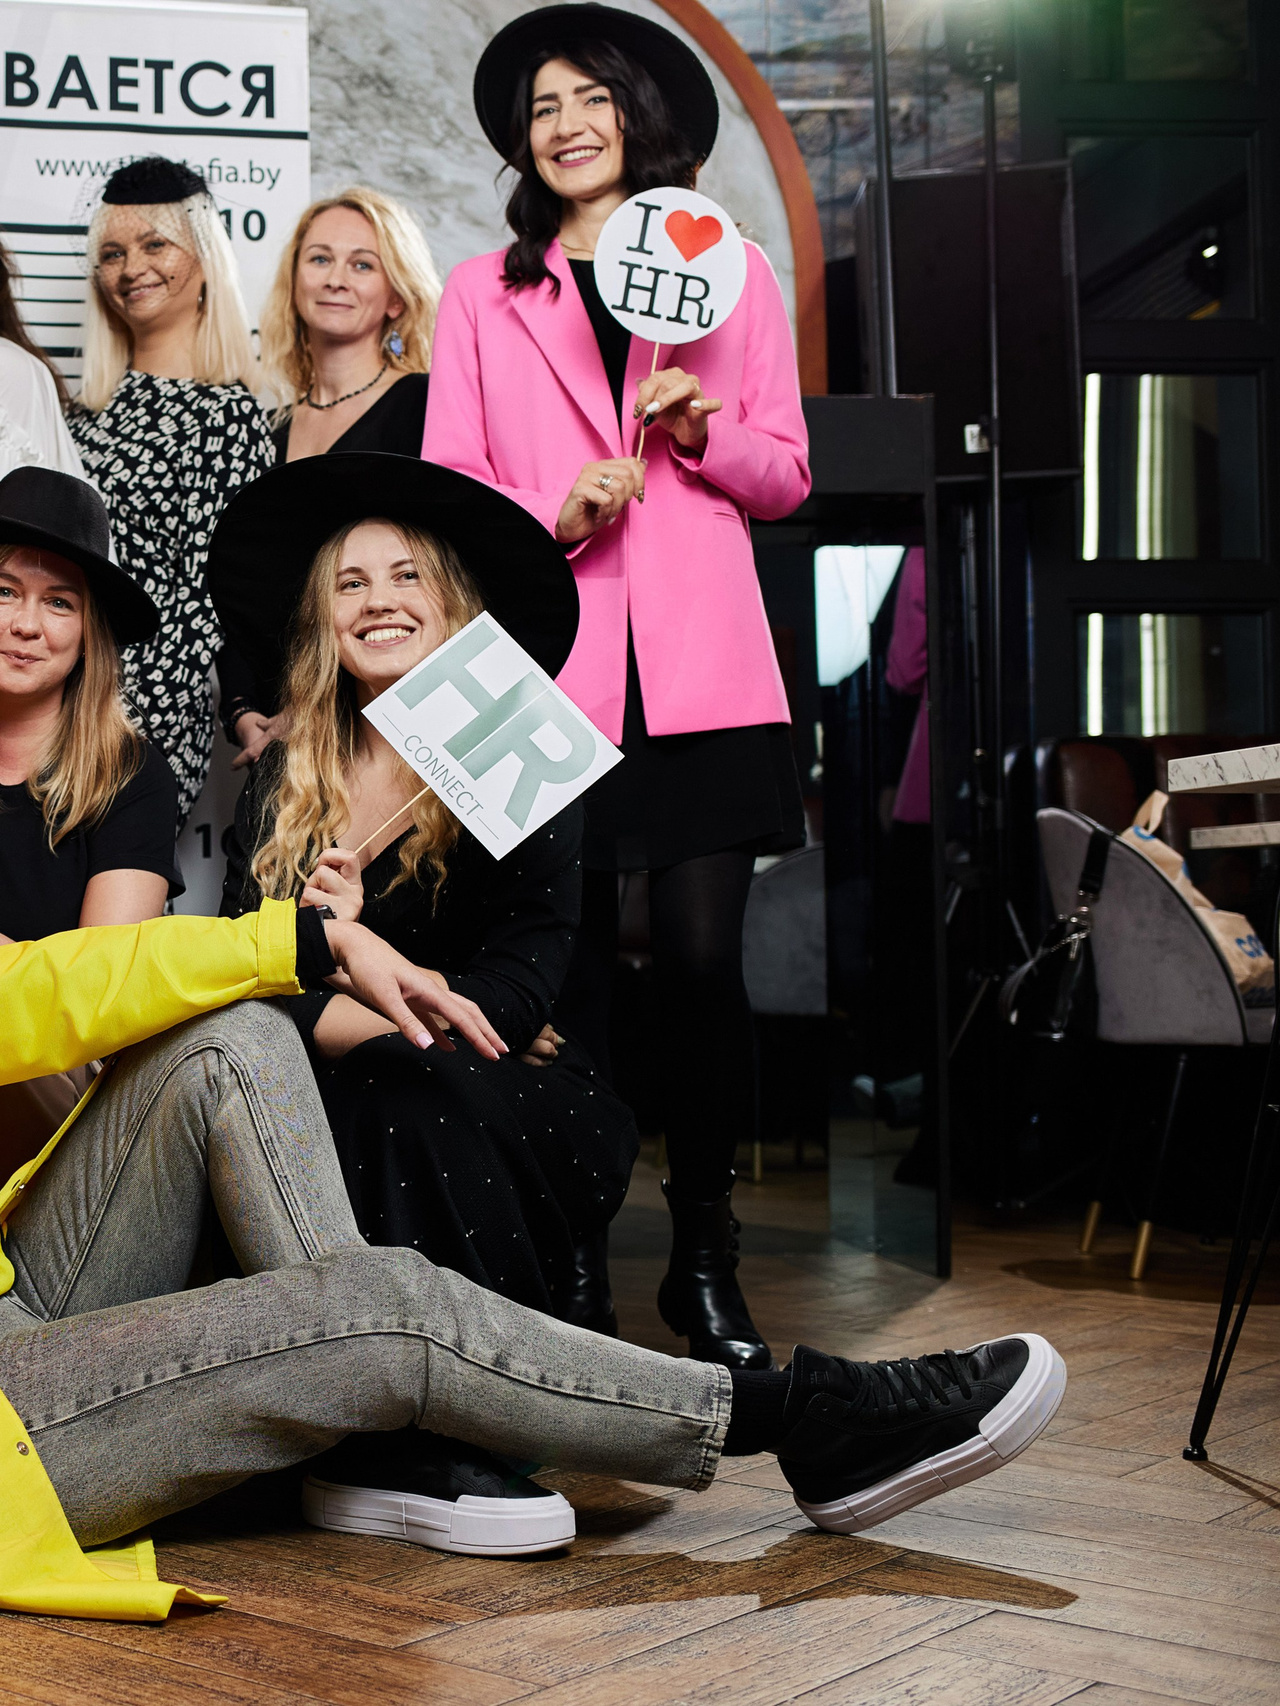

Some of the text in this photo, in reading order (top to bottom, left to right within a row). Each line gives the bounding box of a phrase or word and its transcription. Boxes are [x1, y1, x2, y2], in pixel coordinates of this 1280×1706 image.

[626, 201, 662, 256] I
[611, 260, 714, 329] HR
[394, 620, 597, 832] HR
[403, 734, 484, 817] CONNECT
